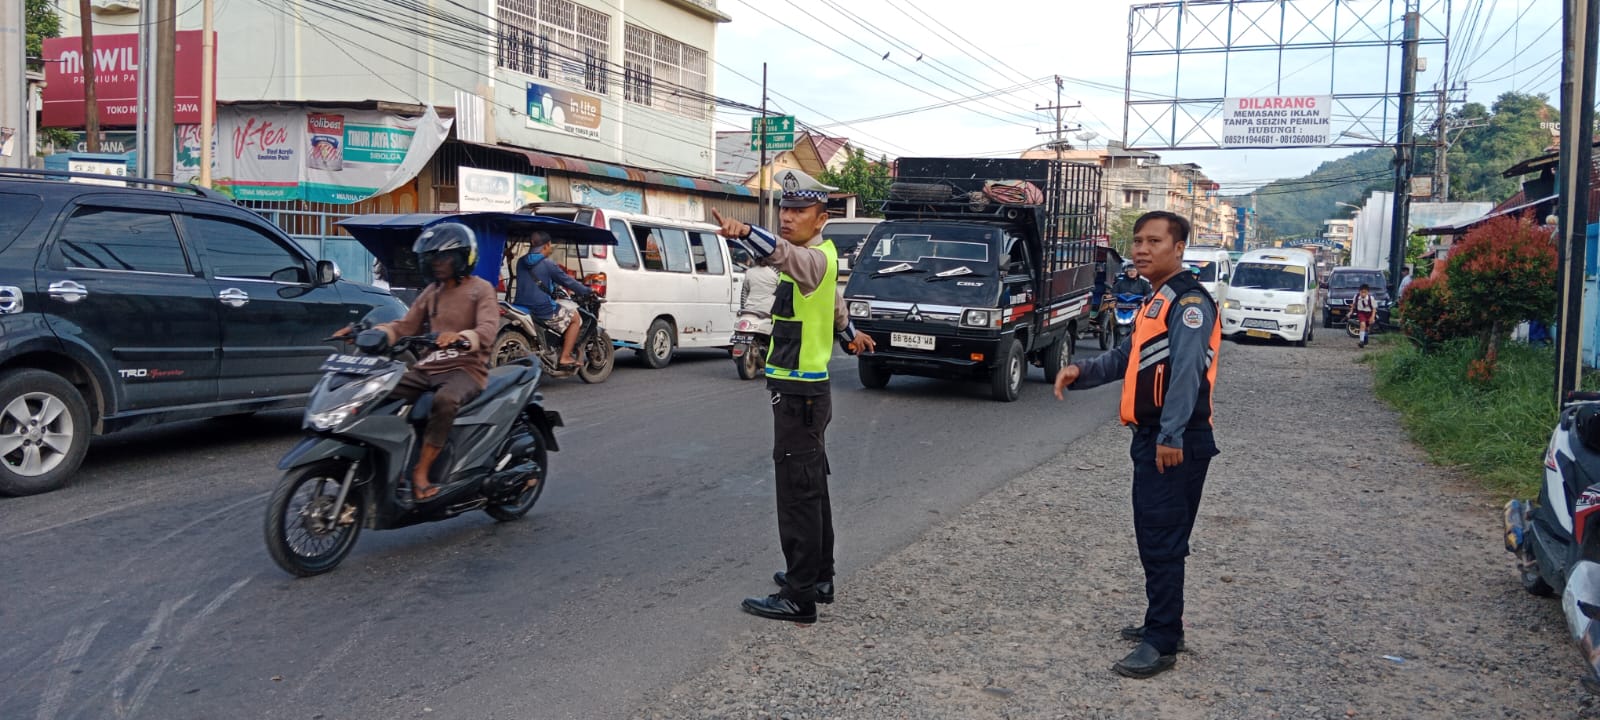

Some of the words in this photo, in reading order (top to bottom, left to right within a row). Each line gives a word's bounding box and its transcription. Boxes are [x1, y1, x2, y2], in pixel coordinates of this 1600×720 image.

[1239, 97, 1315, 109] DILARANG
[106, 106, 129, 115] TOKO
[176, 104, 199, 113] JAYA
[1290, 117, 1329, 125] PEMILIK
[118, 368, 148, 378] TRD
